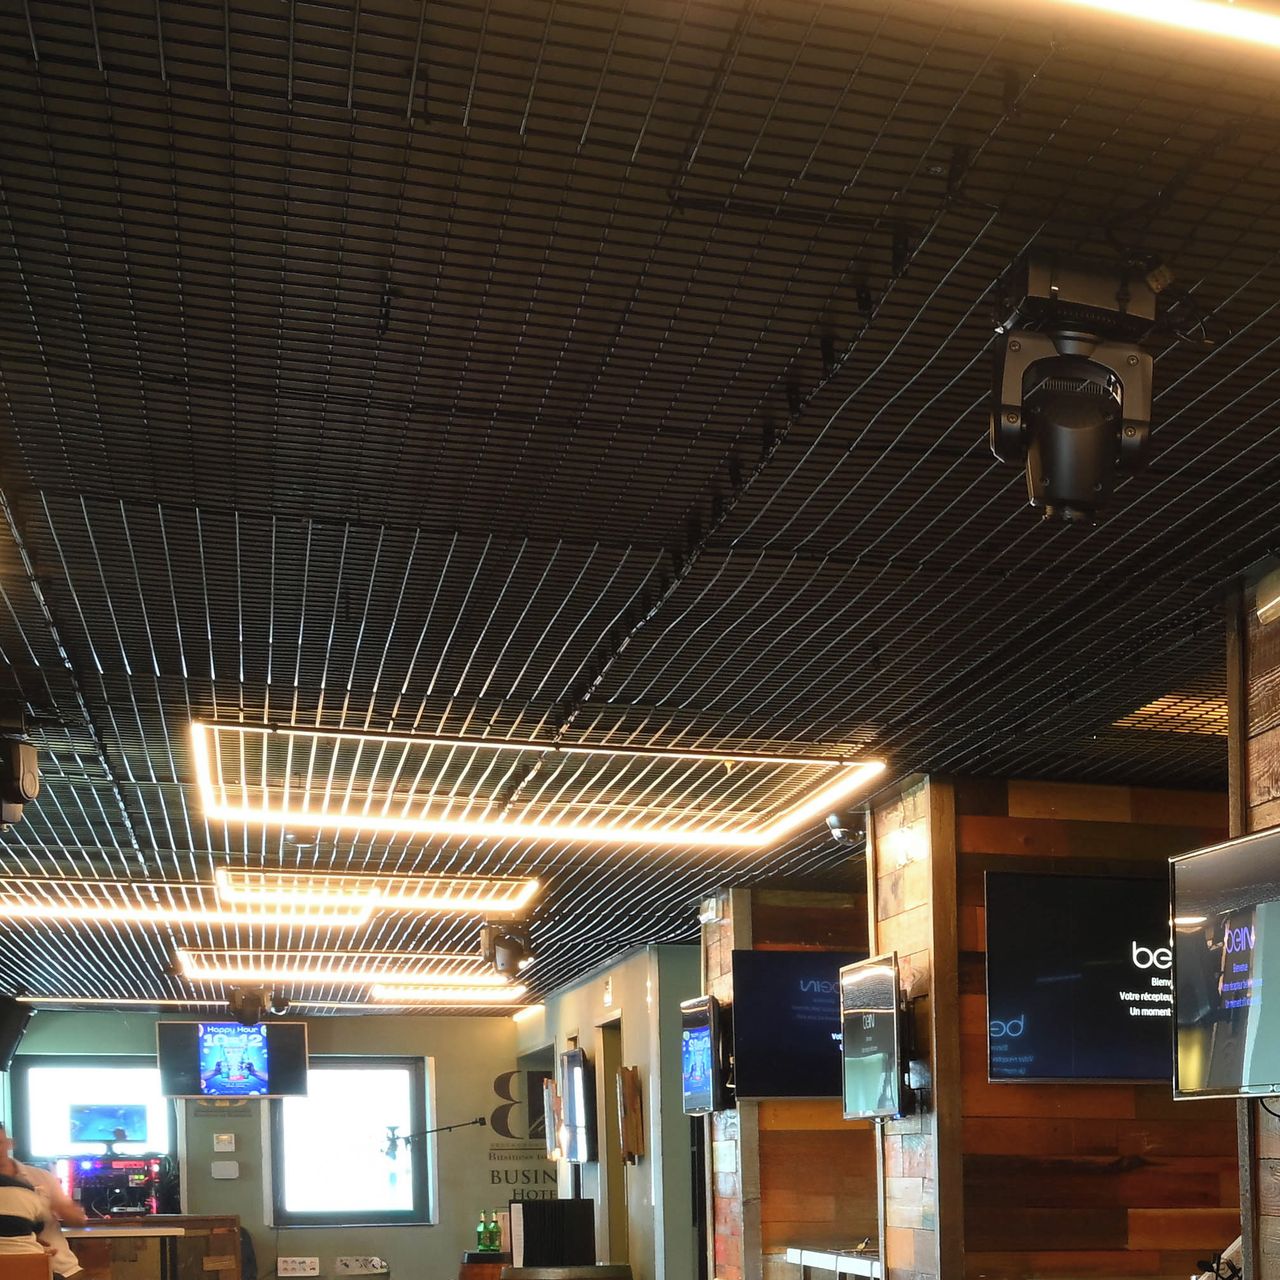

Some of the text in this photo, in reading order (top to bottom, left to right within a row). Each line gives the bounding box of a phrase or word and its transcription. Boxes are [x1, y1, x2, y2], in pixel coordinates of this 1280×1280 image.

[1119, 991, 1140, 1001] Votre
[1129, 1007, 1171, 1017] Un moment
